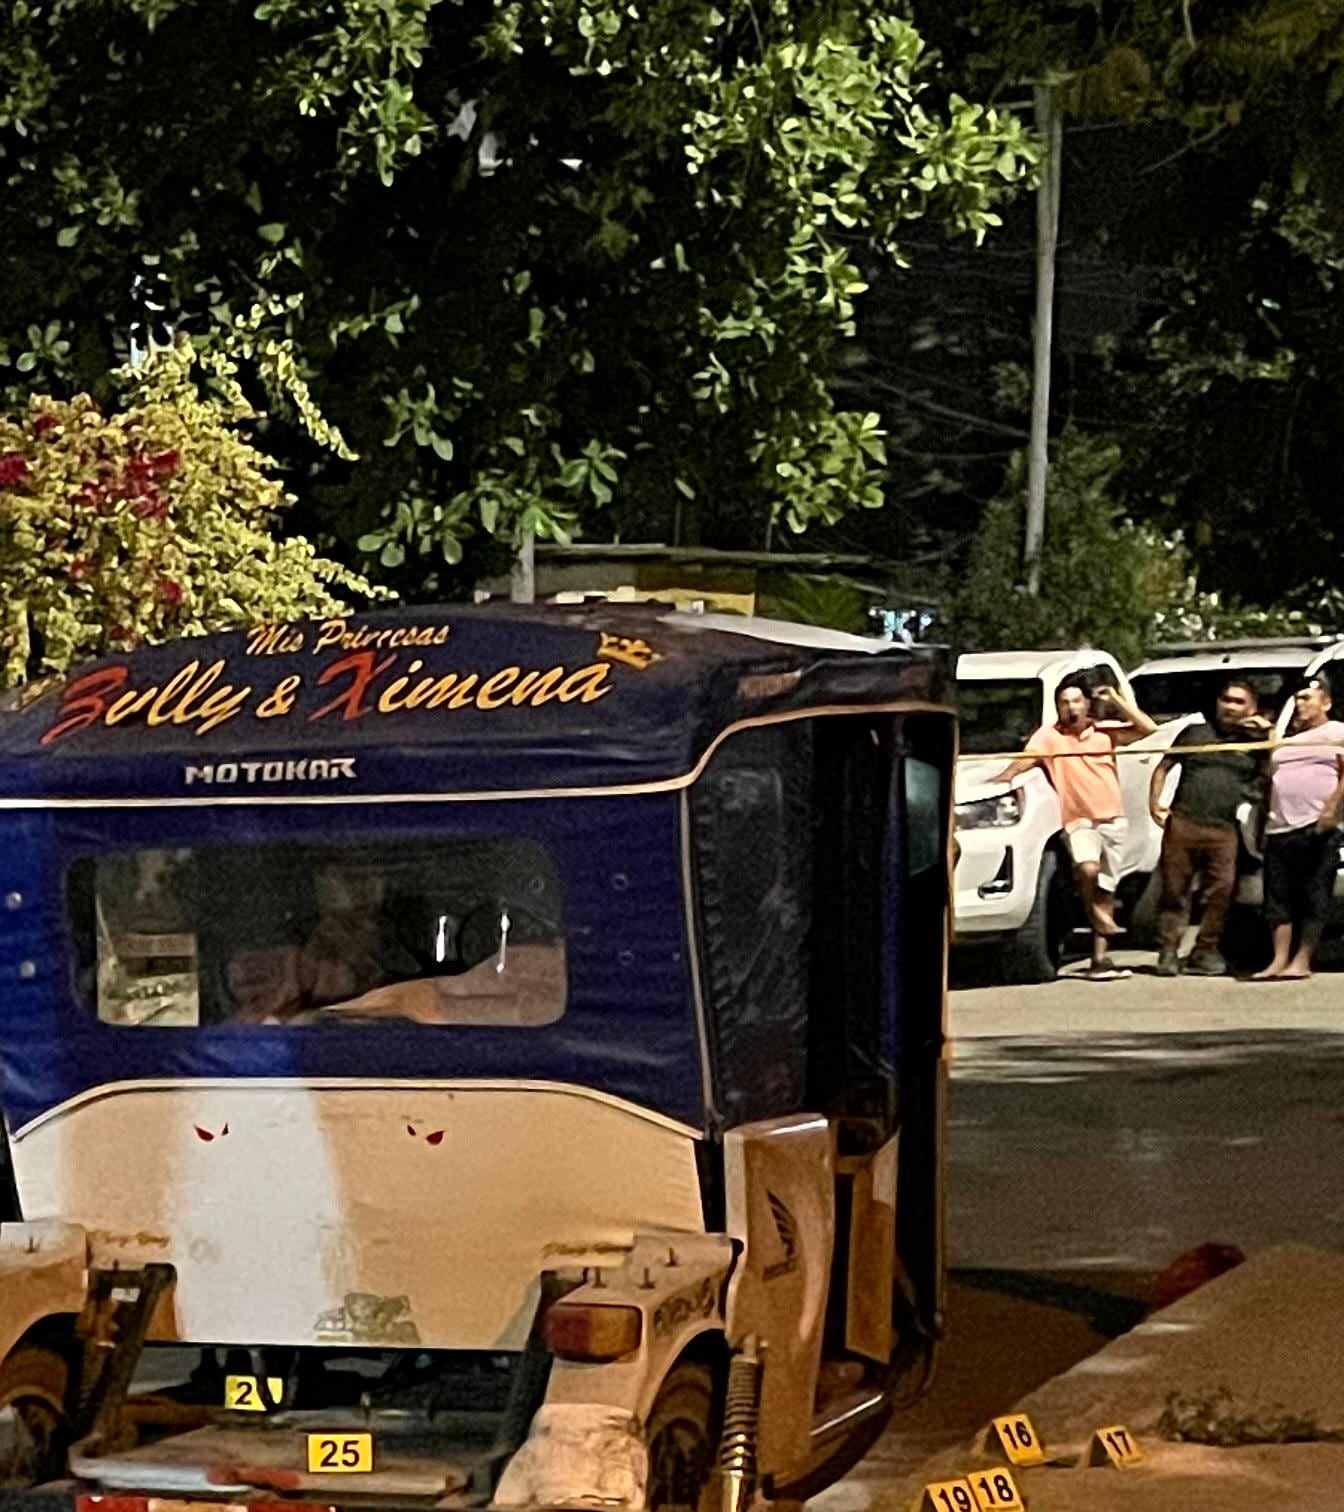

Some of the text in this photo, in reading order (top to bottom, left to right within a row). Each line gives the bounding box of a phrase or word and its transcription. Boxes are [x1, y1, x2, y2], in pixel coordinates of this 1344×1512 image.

[246, 623, 304, 656] Mis
[255, 675, 302, 718] &
[307, 650, 613, 721] Ximena
[184, 757, 357, 785] MOTOKAR
[1003, 1421, 1032, 1450] 16
[1106, 1430, 1132, 1457] 17
[320, 1440, 360, 1467] 25
[978, 1474, 1013, 1505] 18
